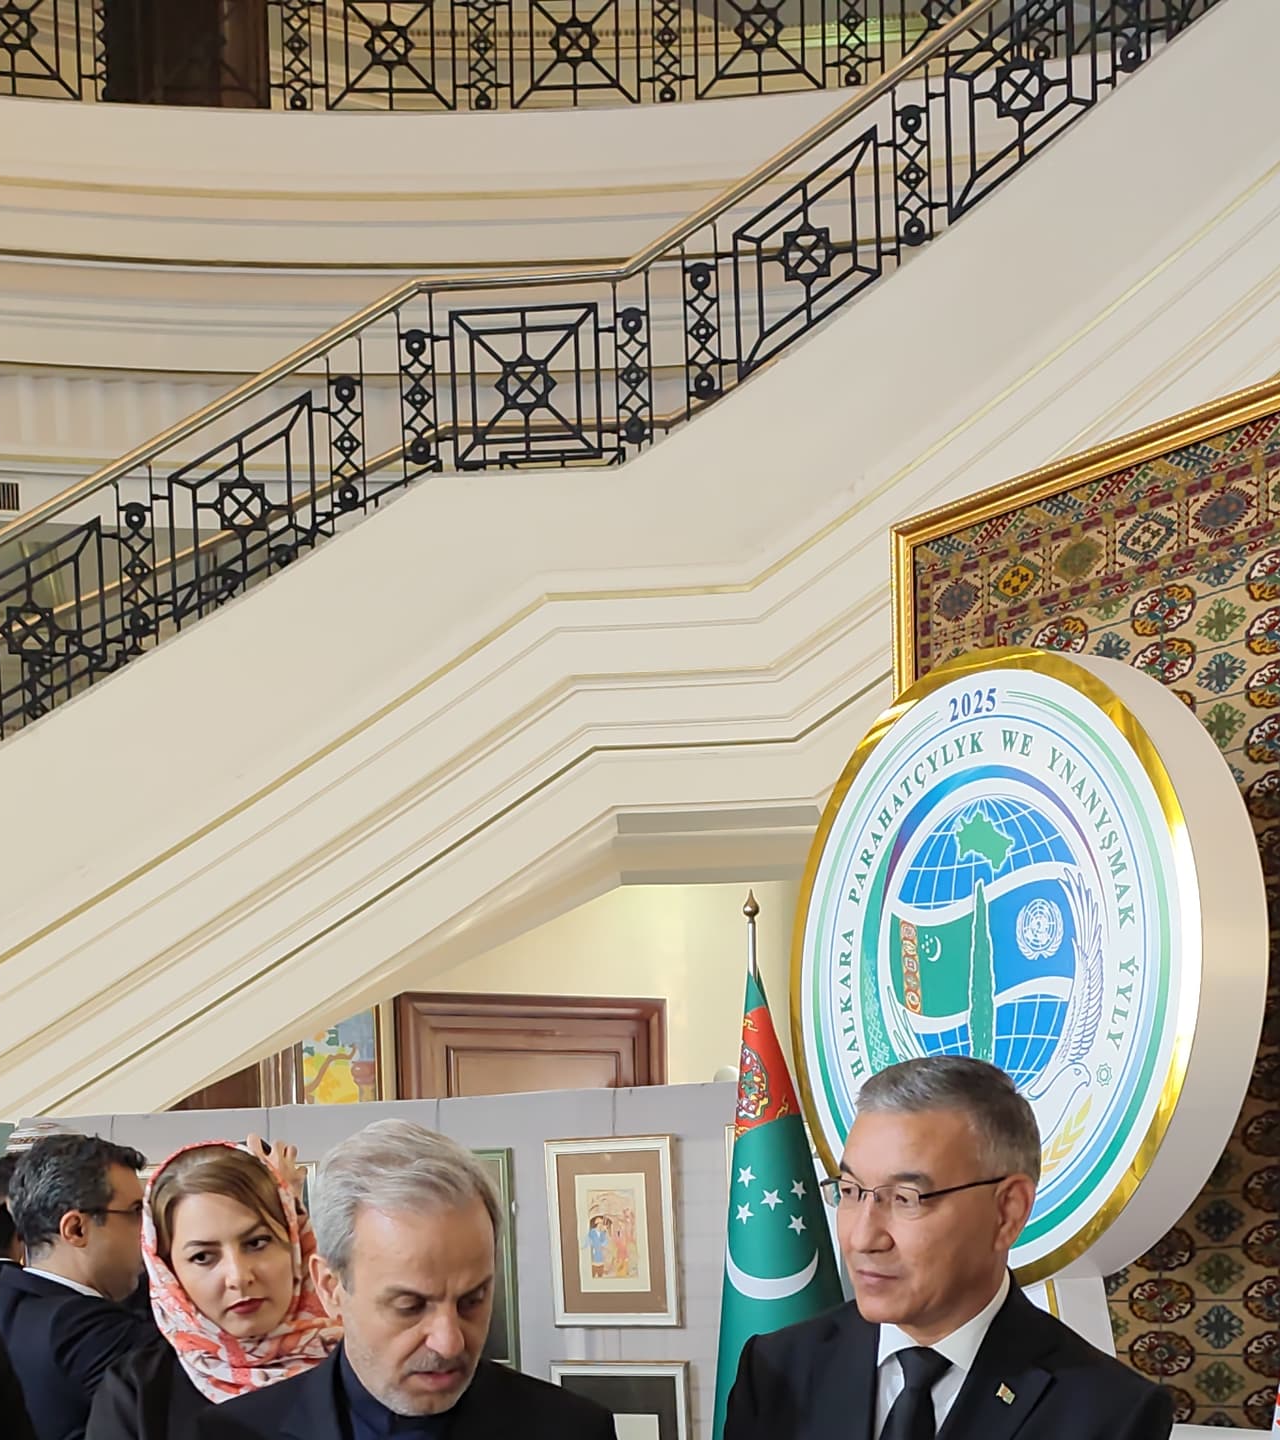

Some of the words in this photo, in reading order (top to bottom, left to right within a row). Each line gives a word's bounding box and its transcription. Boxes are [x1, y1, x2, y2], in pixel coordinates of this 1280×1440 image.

[949, 687, 997, 722] 2025
[1001, 729, 1033, 757] WE
[848, 731, 984, 906] PARAHATÇYLYK
[1047, 747, 1136, 929] YNANYŞMAK
[839, 929, 865, 1080] HALKARA
[1106, 955, 1139, 1051] ÝYLY
